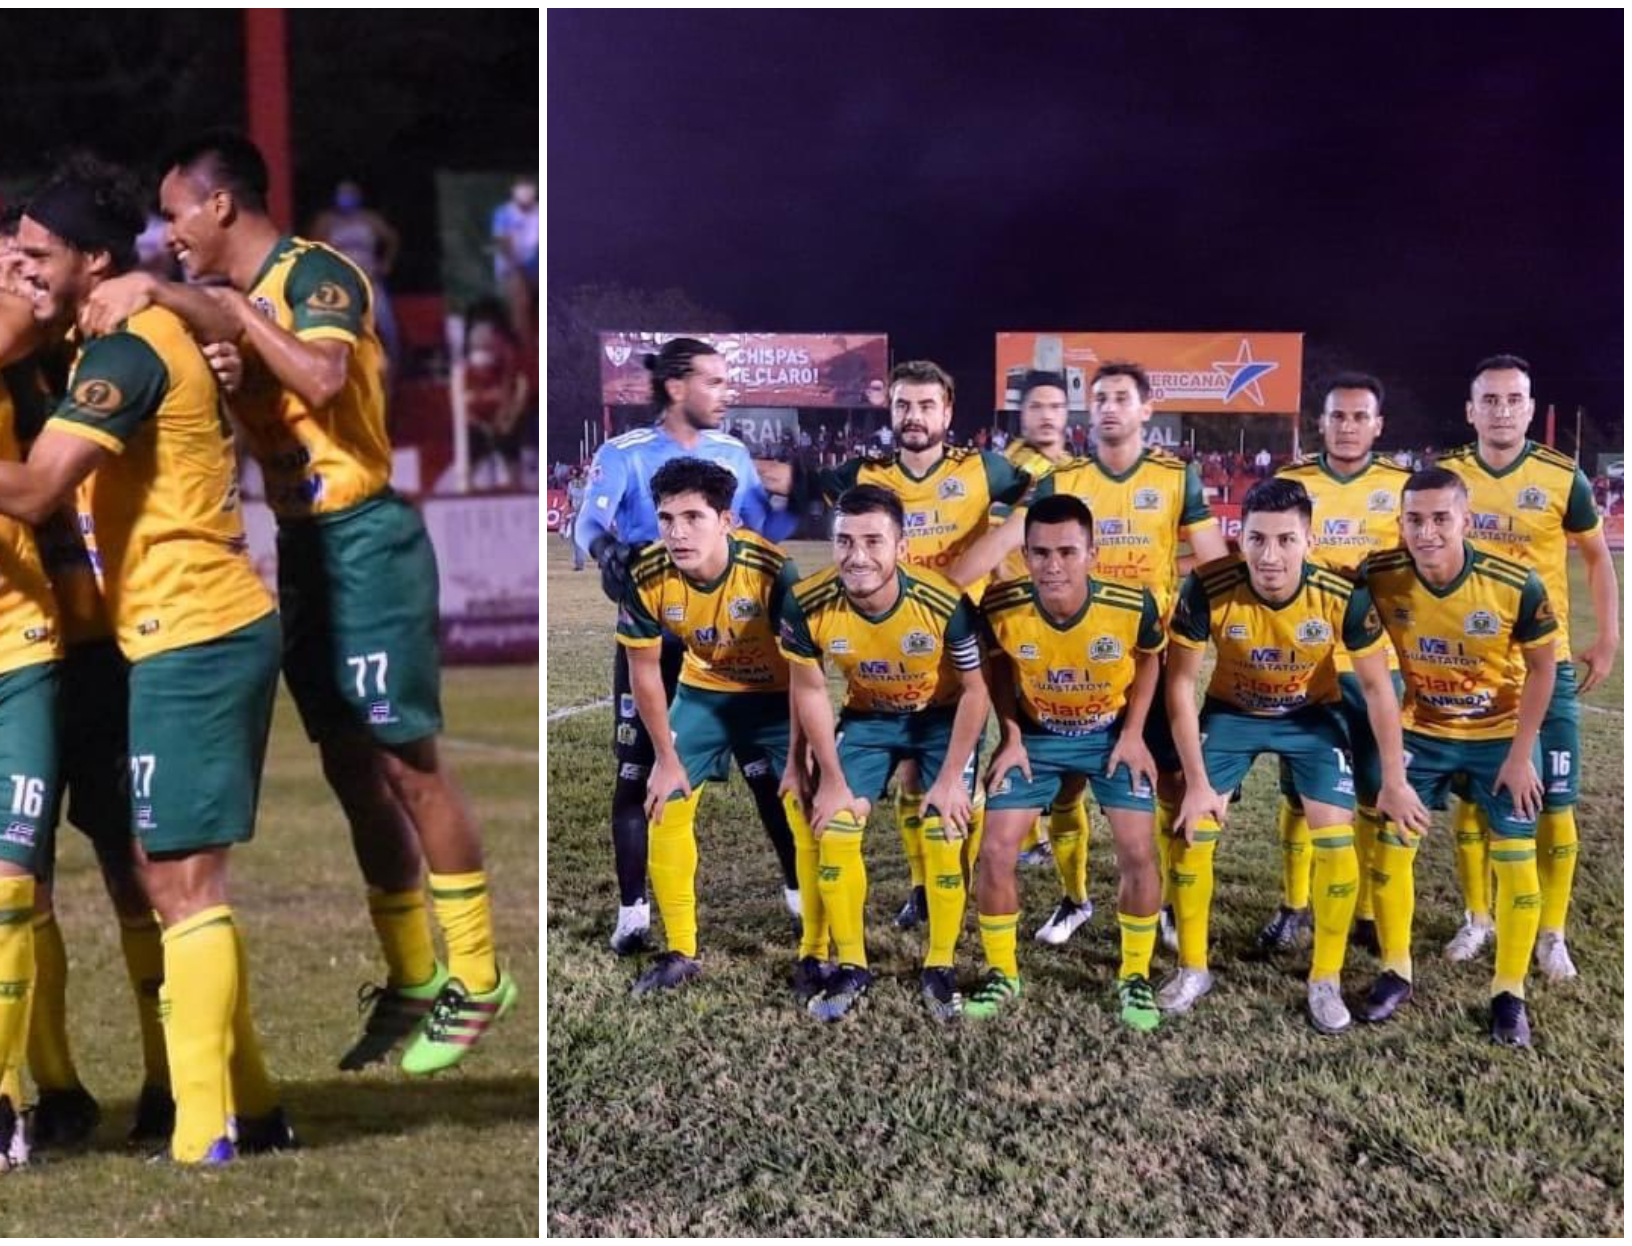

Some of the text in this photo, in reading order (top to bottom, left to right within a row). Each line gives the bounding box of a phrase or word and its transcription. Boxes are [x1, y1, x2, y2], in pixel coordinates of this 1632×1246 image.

[754, 369, 818, 385] CLARO!
[347, 652, 389, 697] 77
[1033, 696, 1108, 717] Claro
[1549, 750, 1571, 776] 16
[11, 774, 45, 818] 16
